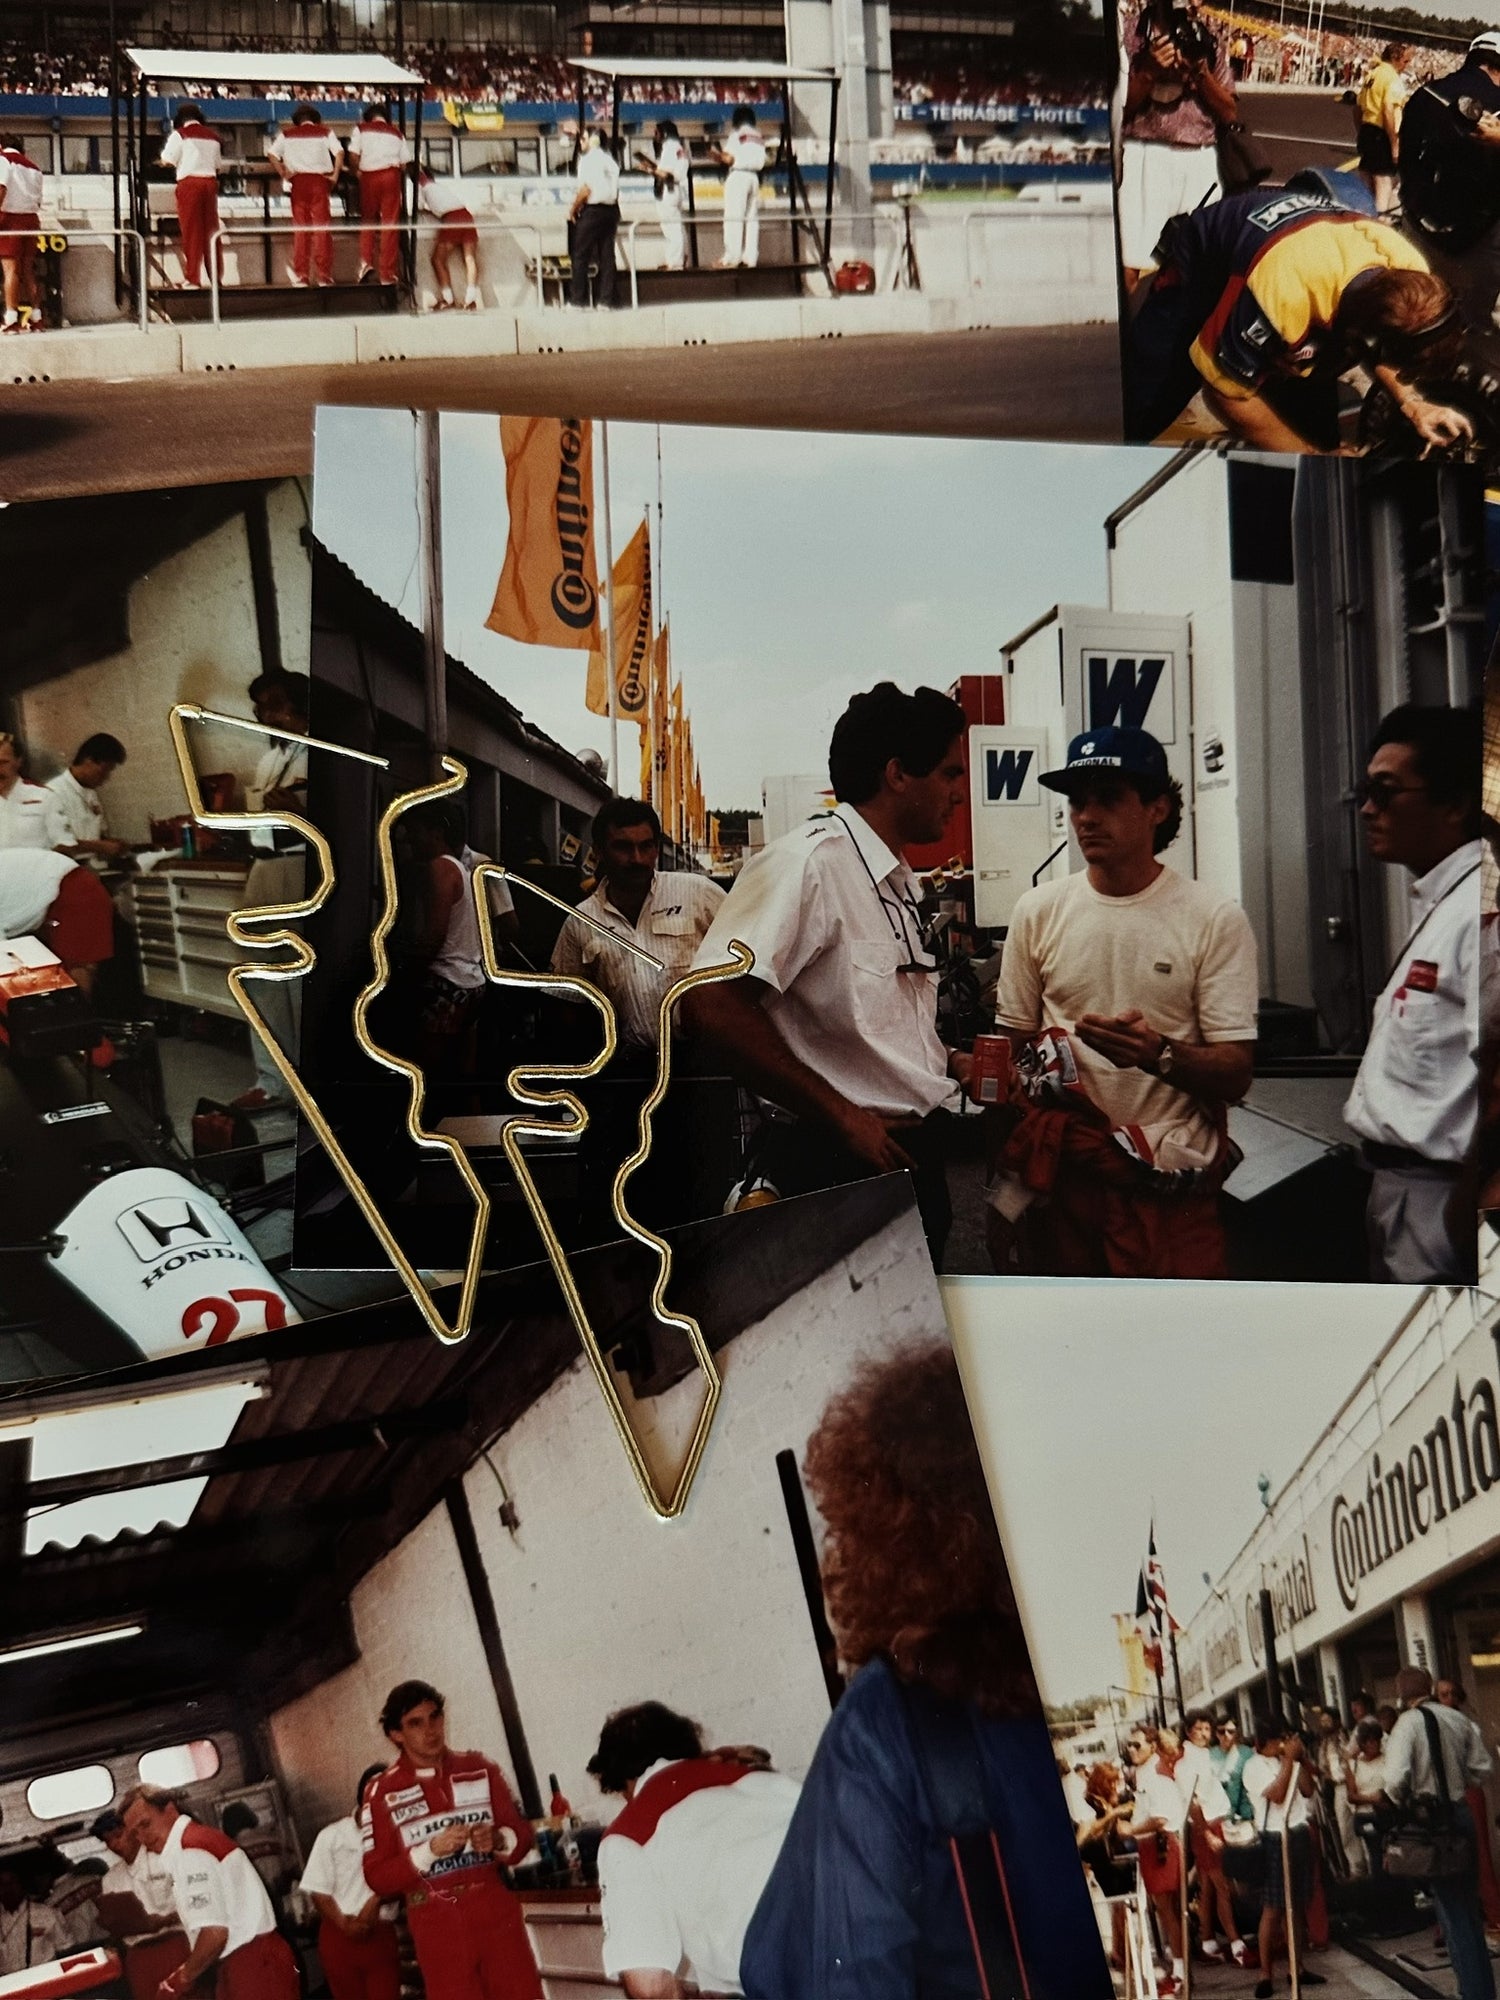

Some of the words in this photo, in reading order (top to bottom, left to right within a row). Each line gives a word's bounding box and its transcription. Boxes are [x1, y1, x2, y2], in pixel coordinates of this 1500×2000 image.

[931, 105, 1019, 123] TERRASSE
[1034, 108, 1086, 124] HOTEL
[141, 1248, 255, 1290] HONDA
[181, 1288, 288, 1347] 27
[425, 1811, 492, 1835] HONDA
